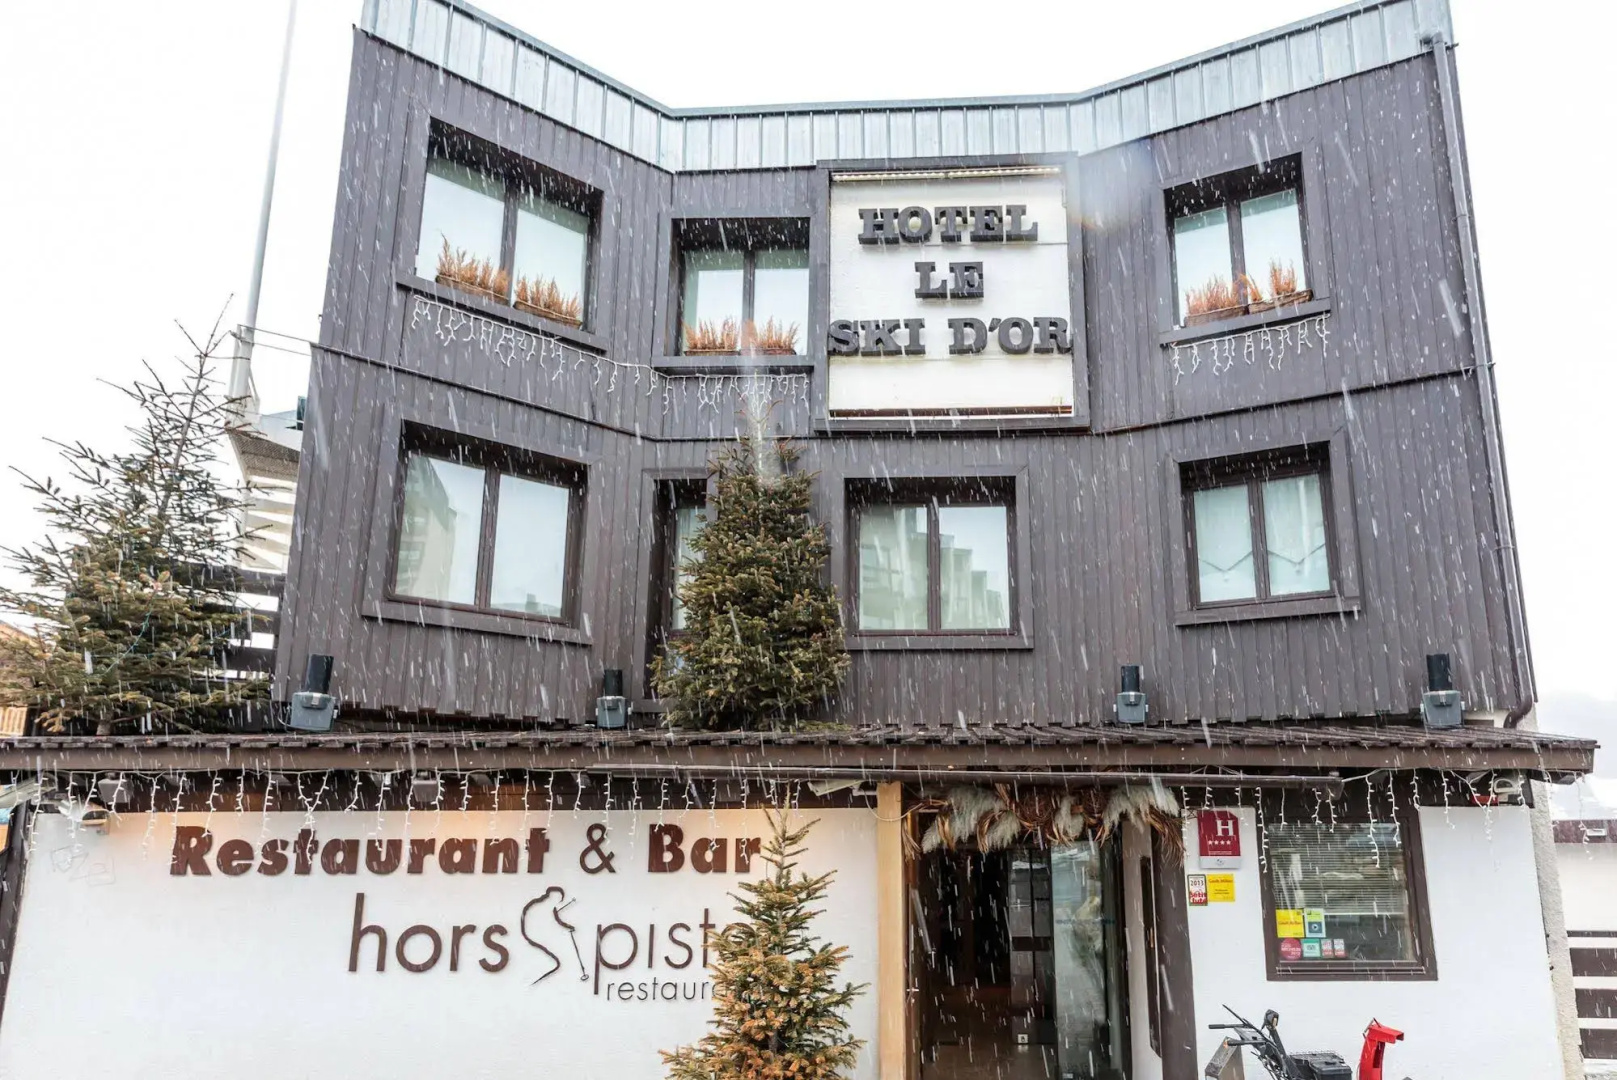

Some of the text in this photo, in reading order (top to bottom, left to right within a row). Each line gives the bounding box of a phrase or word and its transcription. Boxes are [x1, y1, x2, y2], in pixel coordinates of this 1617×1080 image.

[858, 204, 1038, 245] HOTEL
[914, 261, 984, 299] LE
[827, 316, 1074, 357] SKI D'OR
[1215, 819, 1235, 837] H
[170, 823, 761, 876] Restaurant & Bar
[348, 892, 510, 973] hors
